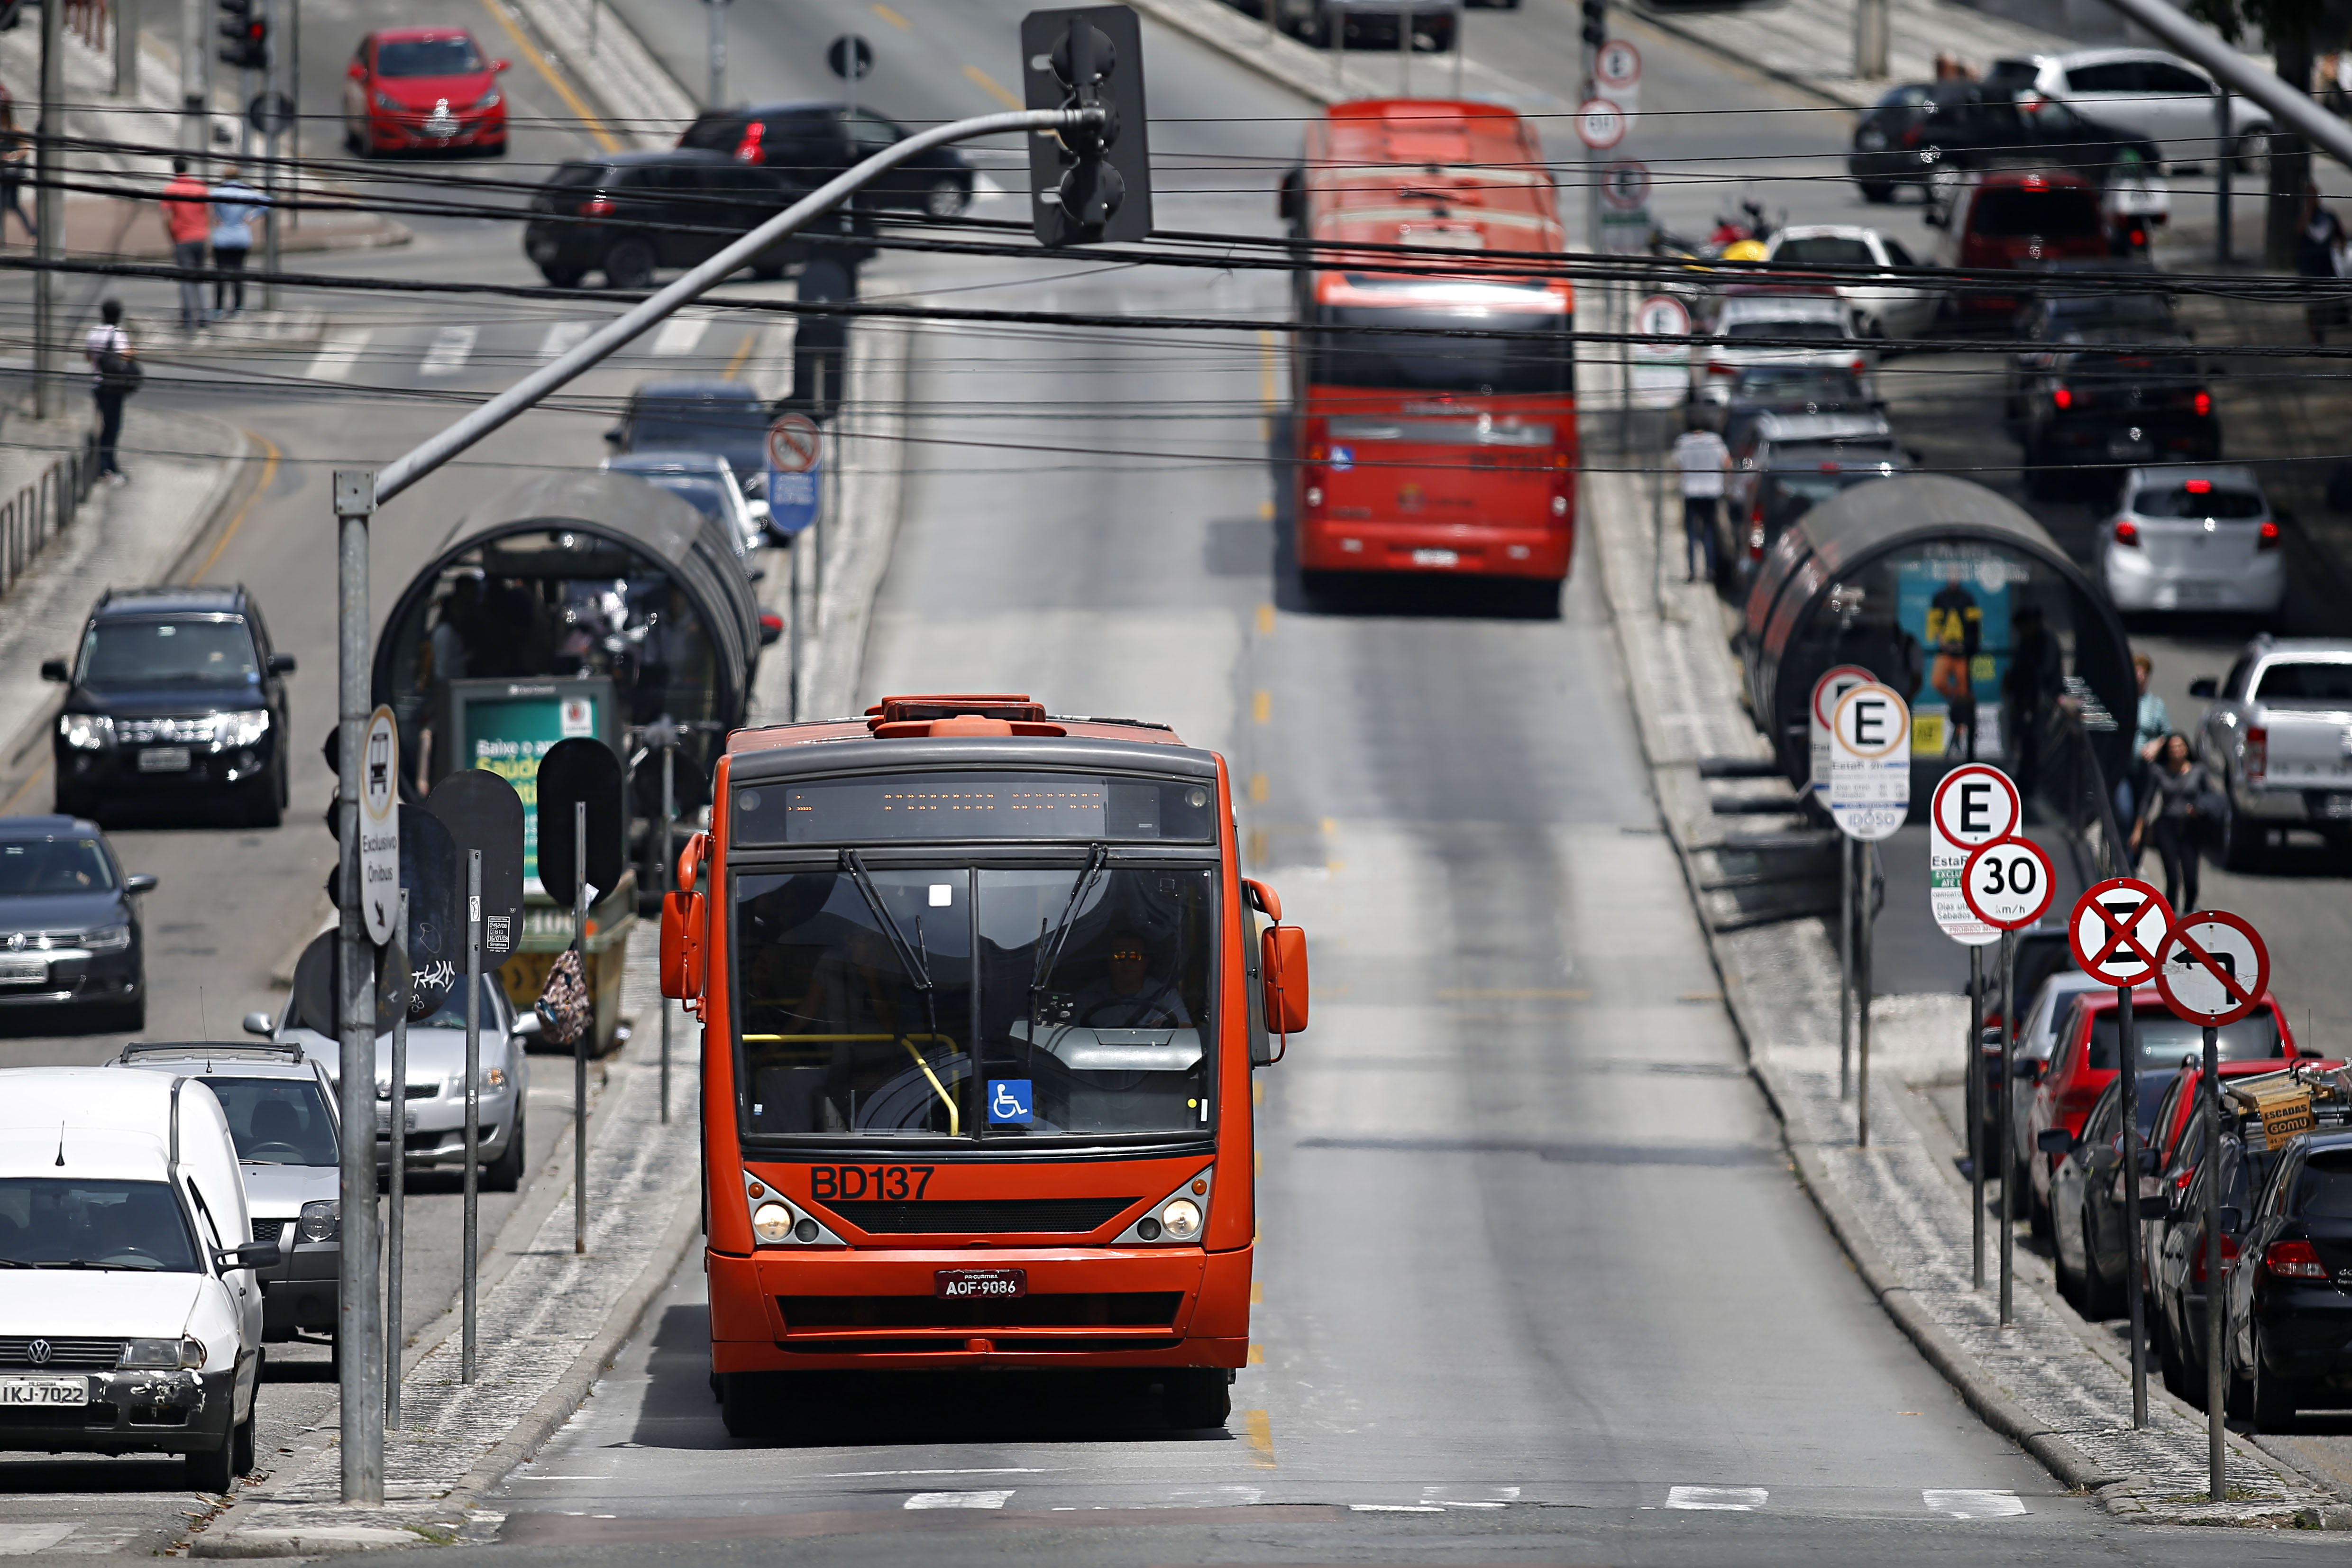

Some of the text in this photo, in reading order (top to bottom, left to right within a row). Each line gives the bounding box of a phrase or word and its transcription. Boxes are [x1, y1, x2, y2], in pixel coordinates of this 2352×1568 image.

[1856, 702, 1885, 744] E
[1961, 784, 1991, 832] E
[363, 834, 397, 853] Exclusivo
[368, 861, 393, 883] Ônibus
[1935, 871, 1962, 879] EXCLU
[1982, 857, 2036, 895] 30
[2265, 1104, 2307, 1119] ESCADAS
[811, 1166, 934, 1200] BD137
